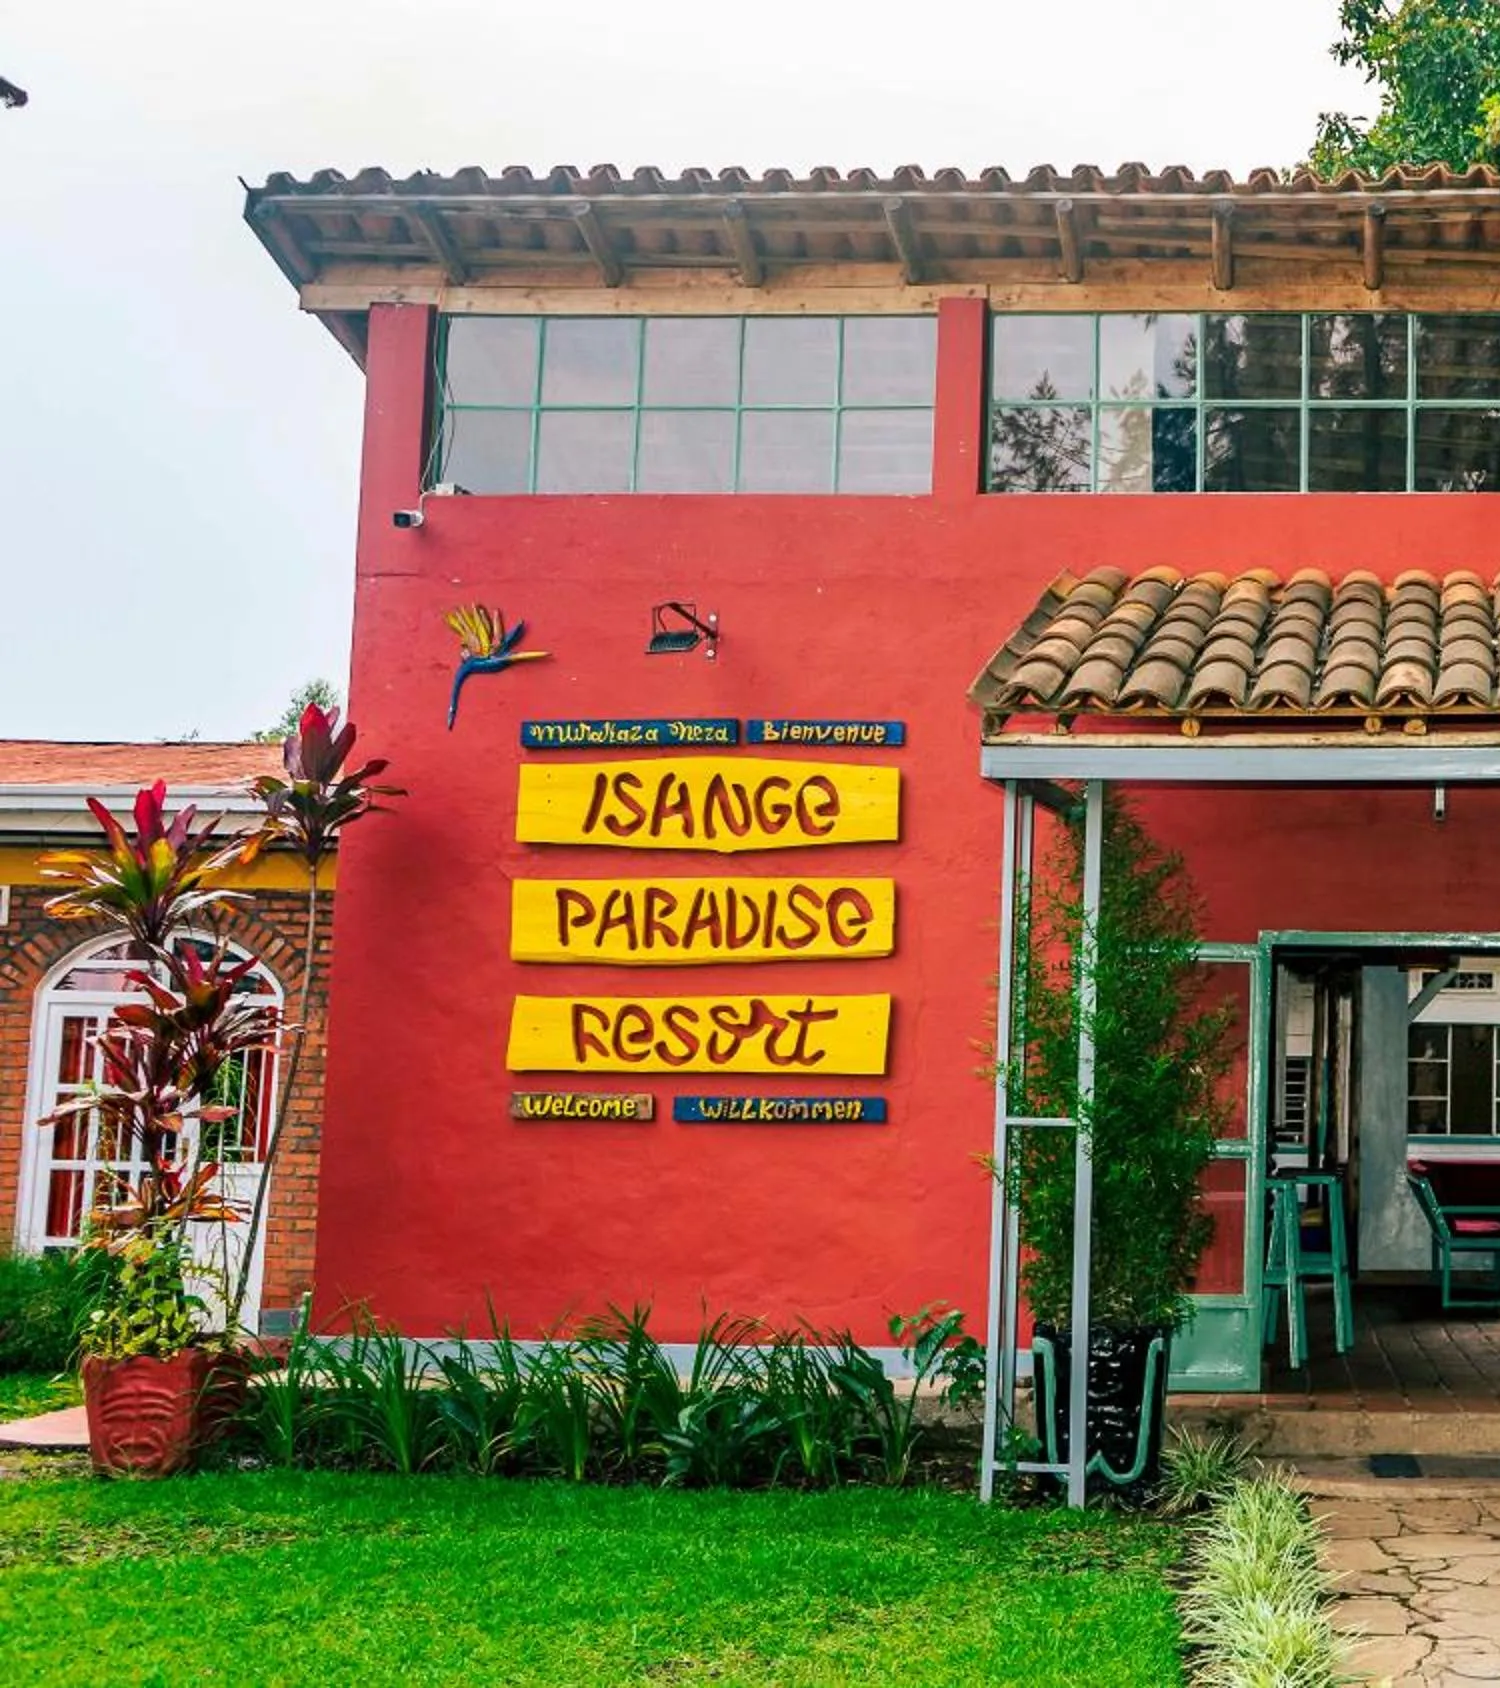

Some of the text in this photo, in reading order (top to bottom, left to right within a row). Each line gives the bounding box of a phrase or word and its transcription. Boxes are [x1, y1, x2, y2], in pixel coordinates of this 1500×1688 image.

[763, 720, 886, 743] Bienvenue
[582, 772, 841, 840] ISANGE
[555, 883, 874, 950] PARADISE
